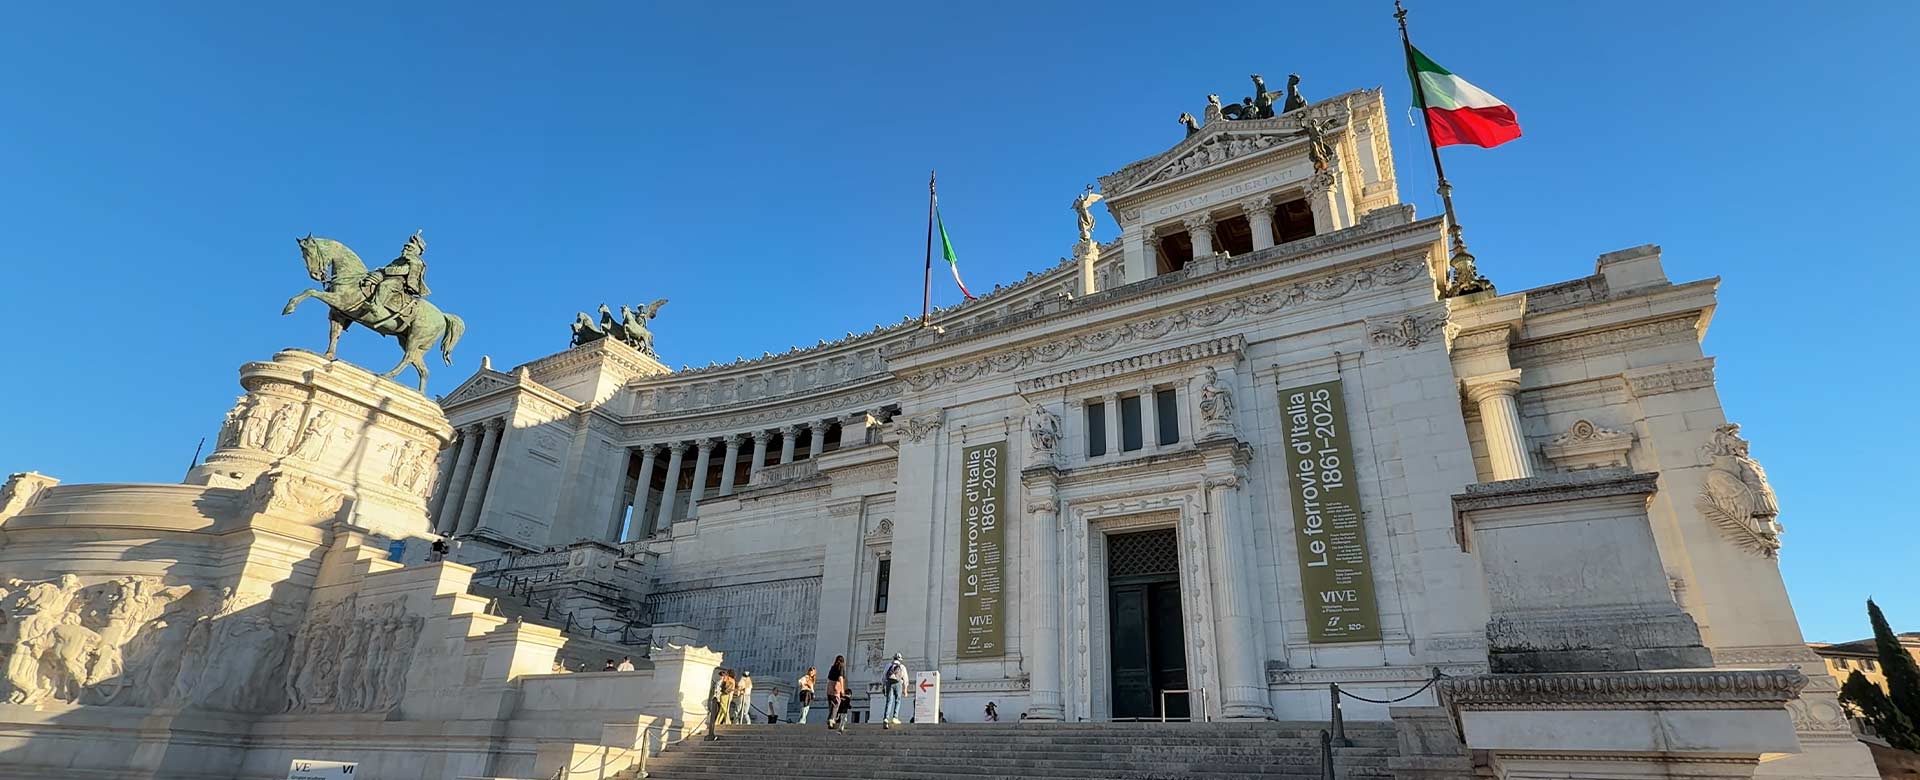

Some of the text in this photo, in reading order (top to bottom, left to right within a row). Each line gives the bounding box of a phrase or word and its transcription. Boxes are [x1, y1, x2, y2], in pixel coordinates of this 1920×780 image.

[1221, 170, 1293, 198] LIBERTATI
[1287, 392, 1328, 567] Le ferrovie d'Italia
[964, 450, 981, 597] Le ferrovie d'Italia
[1320, 589, 1357, 603] VIVE
[969, 614, 993, 626] VIVE
[295, 762, 354, 774] VE VI
